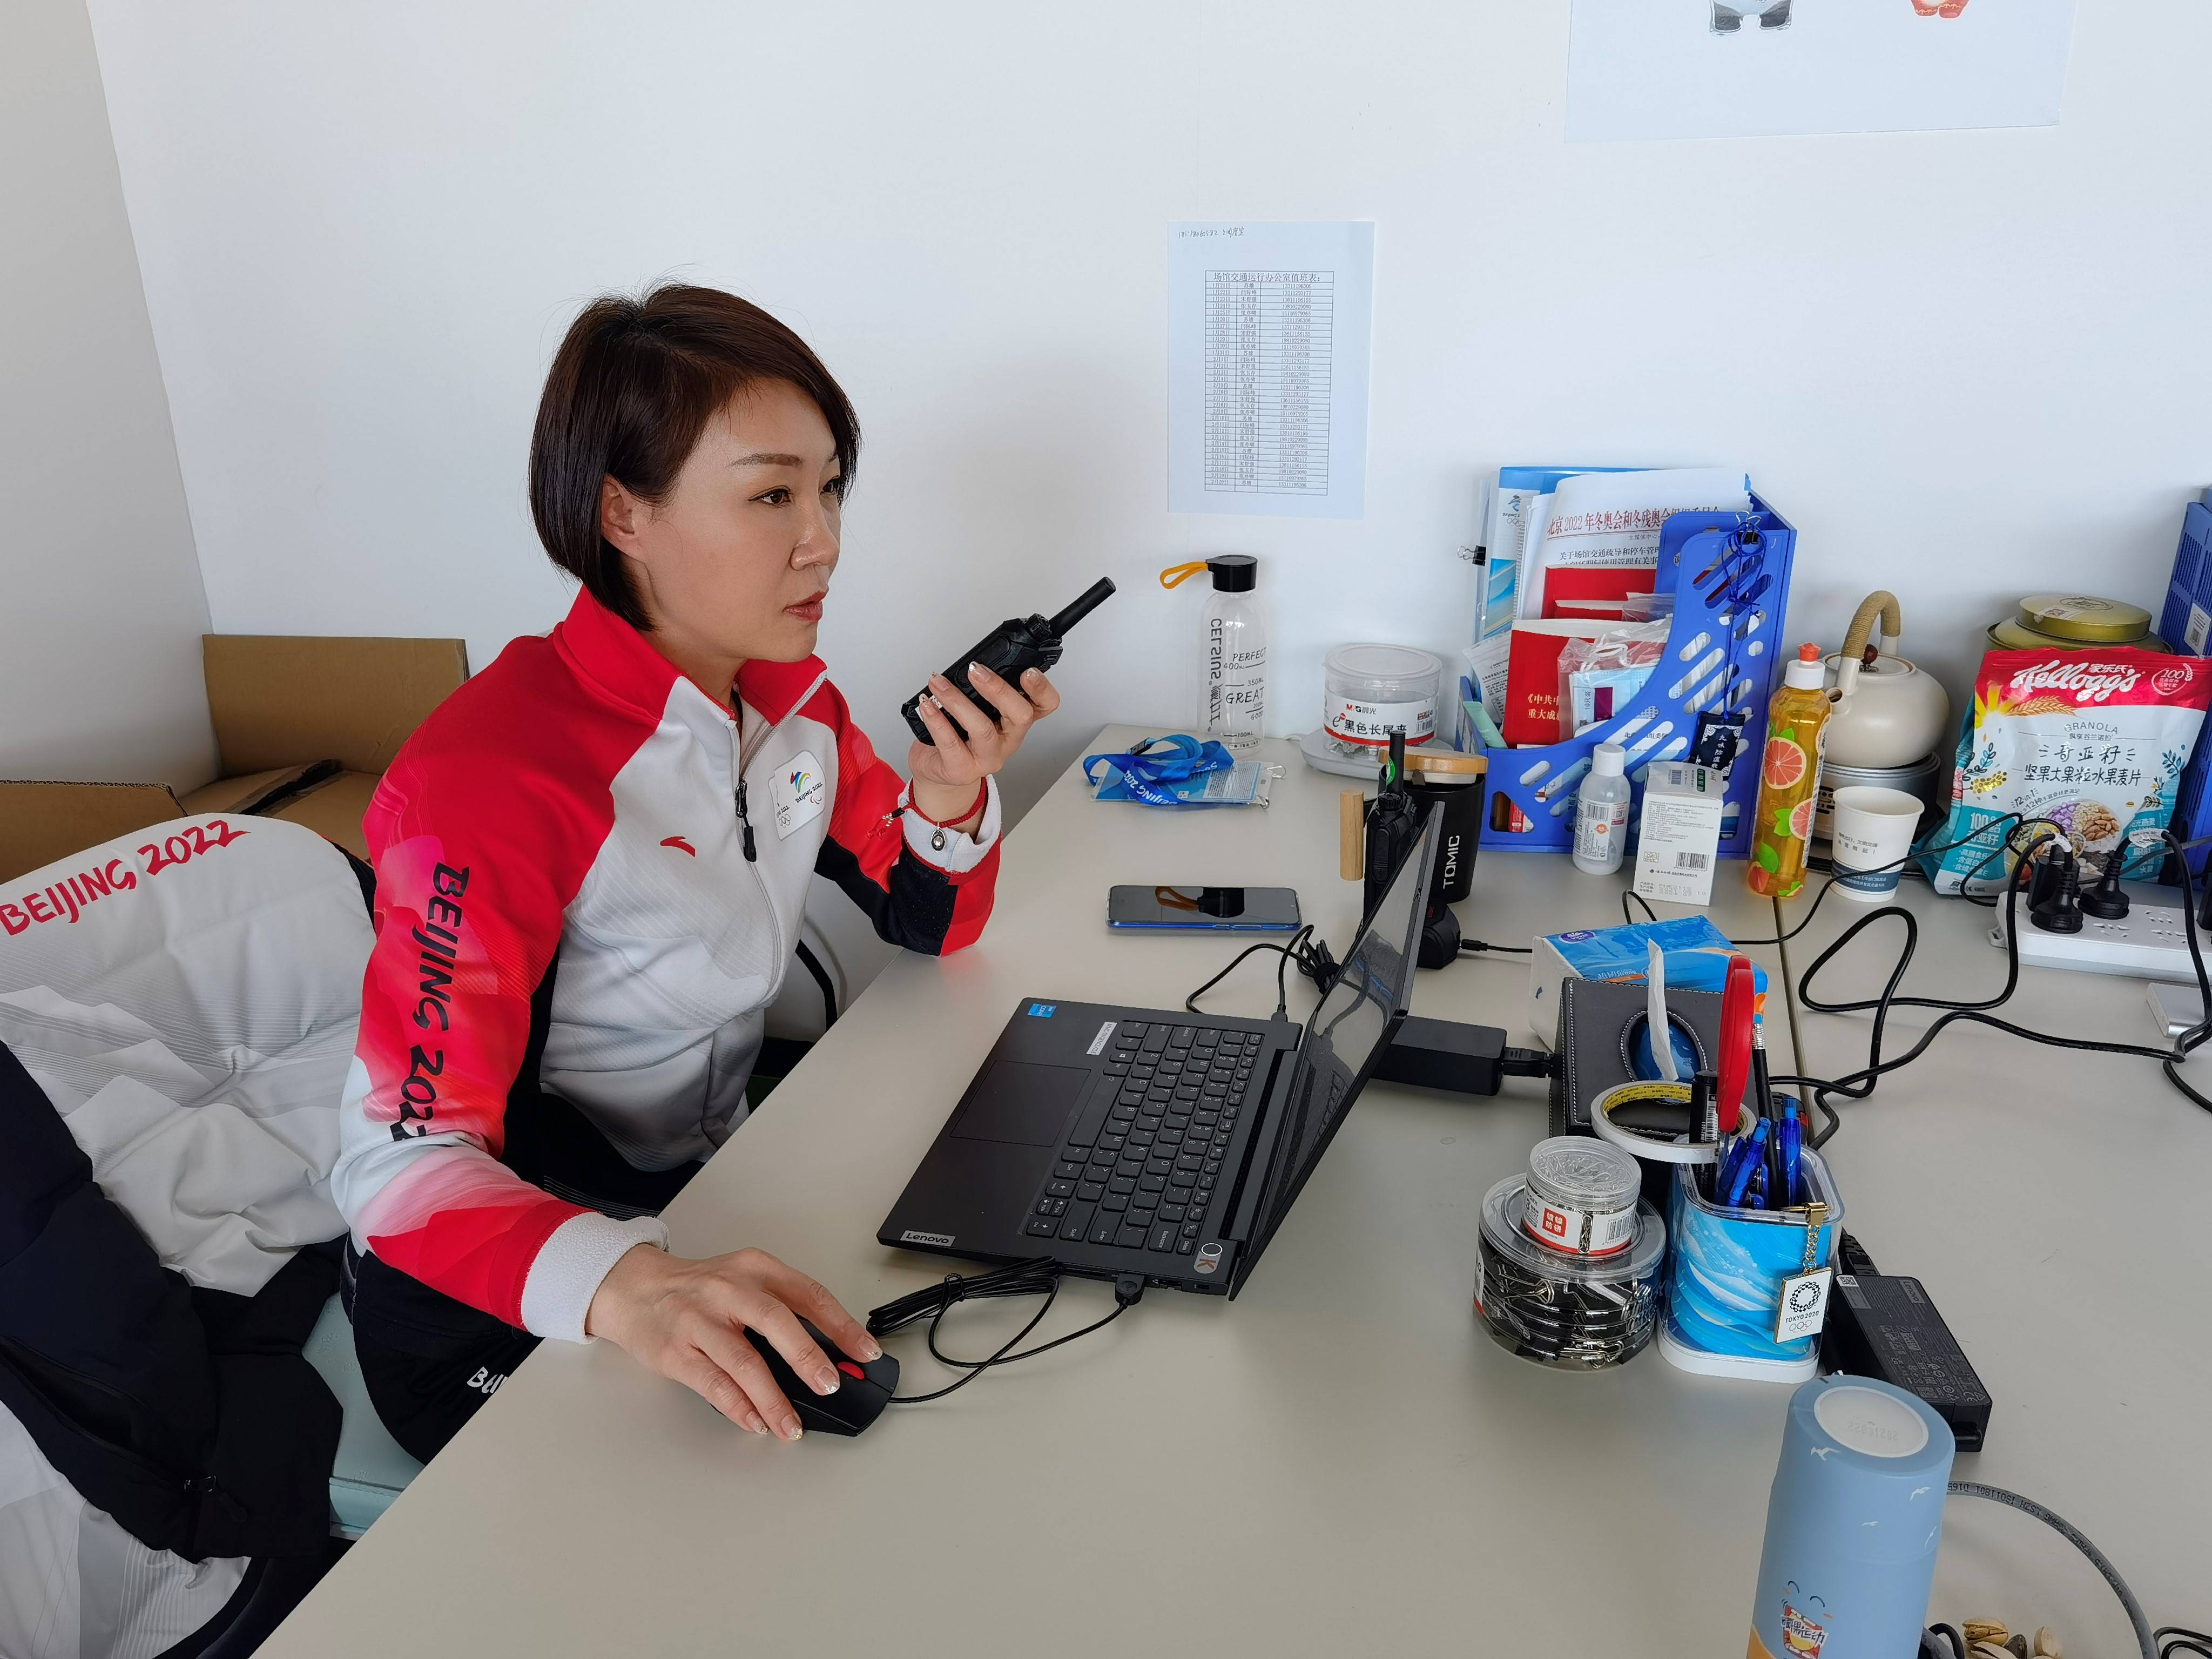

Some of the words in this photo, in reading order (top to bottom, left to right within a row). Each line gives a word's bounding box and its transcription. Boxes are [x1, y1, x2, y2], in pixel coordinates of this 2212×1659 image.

[1547, 516, 1562, 535] 北京
[1564, 517, 1583, 531] 2022
[1232, 646, 1266, 662] PERFECT
[2010, 659, 2142, 702] Kellogg's
[2160, 670, 2184, 679] 100
[1225, 686, 1264, 704] GREAT
[1344, 719, 1407, 736] 黑色长尾夹
[2064, 721, 2119, 736] GRANOLA
[2054, 742, 2121, 765] 奇亚籽
[2024, 764, 2142, 787] 坚果大果粒水果麦片
[795, 789, 812, 804] BEIJING
[1443, 835, 1460, 889] TOMIC
[0, 859, 137, 936] BEIJING
[137, 820, 252, 876] 2022
[412, 861, 470, 1031] BEIJING
[906, 1232, 949, 1243] Lenovo
[1785, 1314, 1804, 1324] TOKYO
[1804, 1311, 1819, 1319] 2020
